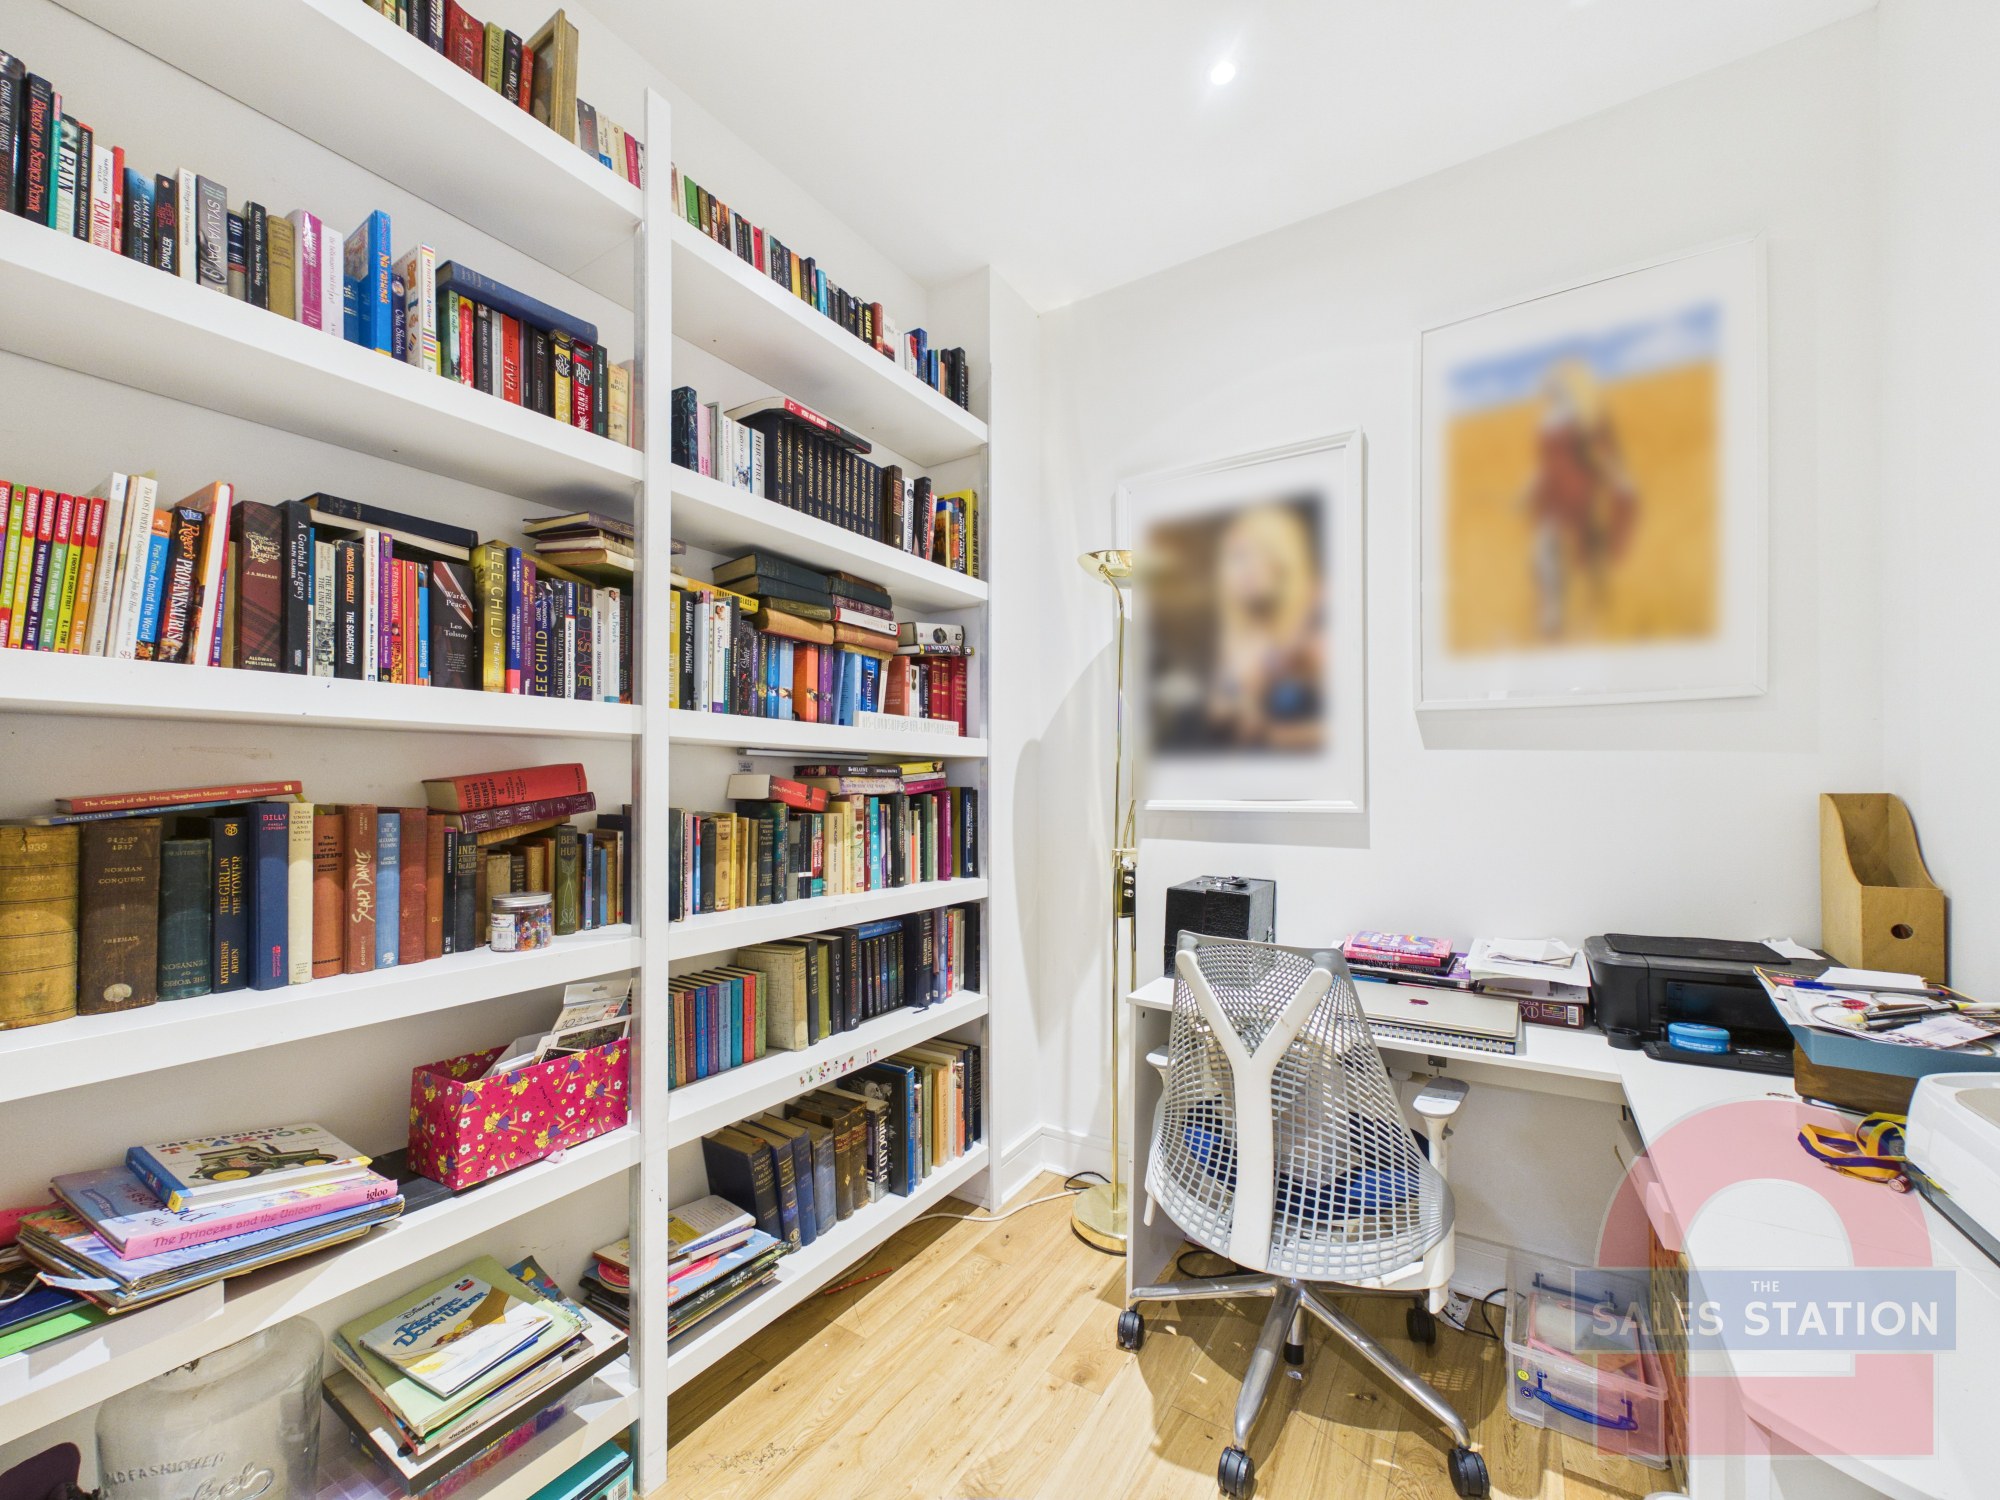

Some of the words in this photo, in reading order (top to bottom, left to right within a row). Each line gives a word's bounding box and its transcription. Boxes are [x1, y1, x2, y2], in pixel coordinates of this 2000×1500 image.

[58, 153, 75, 195] RAIN
[141, 193, 151, 239] SAMANTHA
[206, 199, 221, 239] SYLVIA
[206, 241, 222, 269] DAY
[577, 386, 585, 416] HENDEL
[25, 492, 38, 533] GOOSEBUMPS
[41, 496, 55, 537] GOOSEBUMPS
[58, 500, 71, 539] GOOSEBUMPS
[76, 503, 87, 536] GOOSEBUMPS
[298, 521, 307, 529] A
[178, 521, 200, 560] Roger's
[297, 533, 308, 567] Gorbals
[346, 547, 355, 573] MICHAEL
[491, 551, 505, 585] LEE
[146, 574, 158, 603] Around
[167, 558, 194, 640] PROFANISAURUS
[293, 567, 307, 602] Legacy
[346, 573, 354, 604] CONNELLY
[143, 603, 154, 616] the
[346, 611, 354, 624] THE
[446, 600, 467, 609] Peace
[490, 586, 504, 639] CHILD
[140, 616, 152, 640] World
[443, 629, 468, 640] Tolstoy
[449, 622, 463, 631] Leo
[345, 624, 354, 665] SCARECROW
[535, 631, 548, 672] CHILD
[866, 668, 875, 712] Thesauru
[100, 798, 125, 808] Gospel
[134, 796, 148, 804] the
[148, 793, 171, 803] Flying
[171, 792, 201, 801] Spaghetti
[261, 814, 287, 822] BILLY
[560, 835, 576, 844] BEN
[560, 847, 576, 856] HUR
[104, 866, 143, 874] NORMAN
[220, 857, 229, 866] IN
[231, 855, 243, 895] TOWER
[351, 848, 372, 889] DANCE
[219, 867, 231, 896] GIRL
[220, 896, 230, 915] THE
[232, 895, 241, 916] THE
[351, 888, 375, 924] SCALP
[220, 940, 230, 985] KATHERINE
[231, 948, 239, 974] ARDEN
[160, 1126, 320, 1155] TRAKTOR
[878, 1114, 888, 1168] AutoCAD
[878, 1170, 888, 1183] 14
[153, 1235, 177, 1248] The
[180, 1223, 233, 1243] Princess
[235, 1216, 258, 1229] and
[260, 1211, 278, 1224] the
[279, 1202, 322, 1219] Unicorn
[366, 1187, 388, 1201] igloo
[392, 1316, 446, 1347] DOWN
[445, 1291, 489, 1320] UNDER
